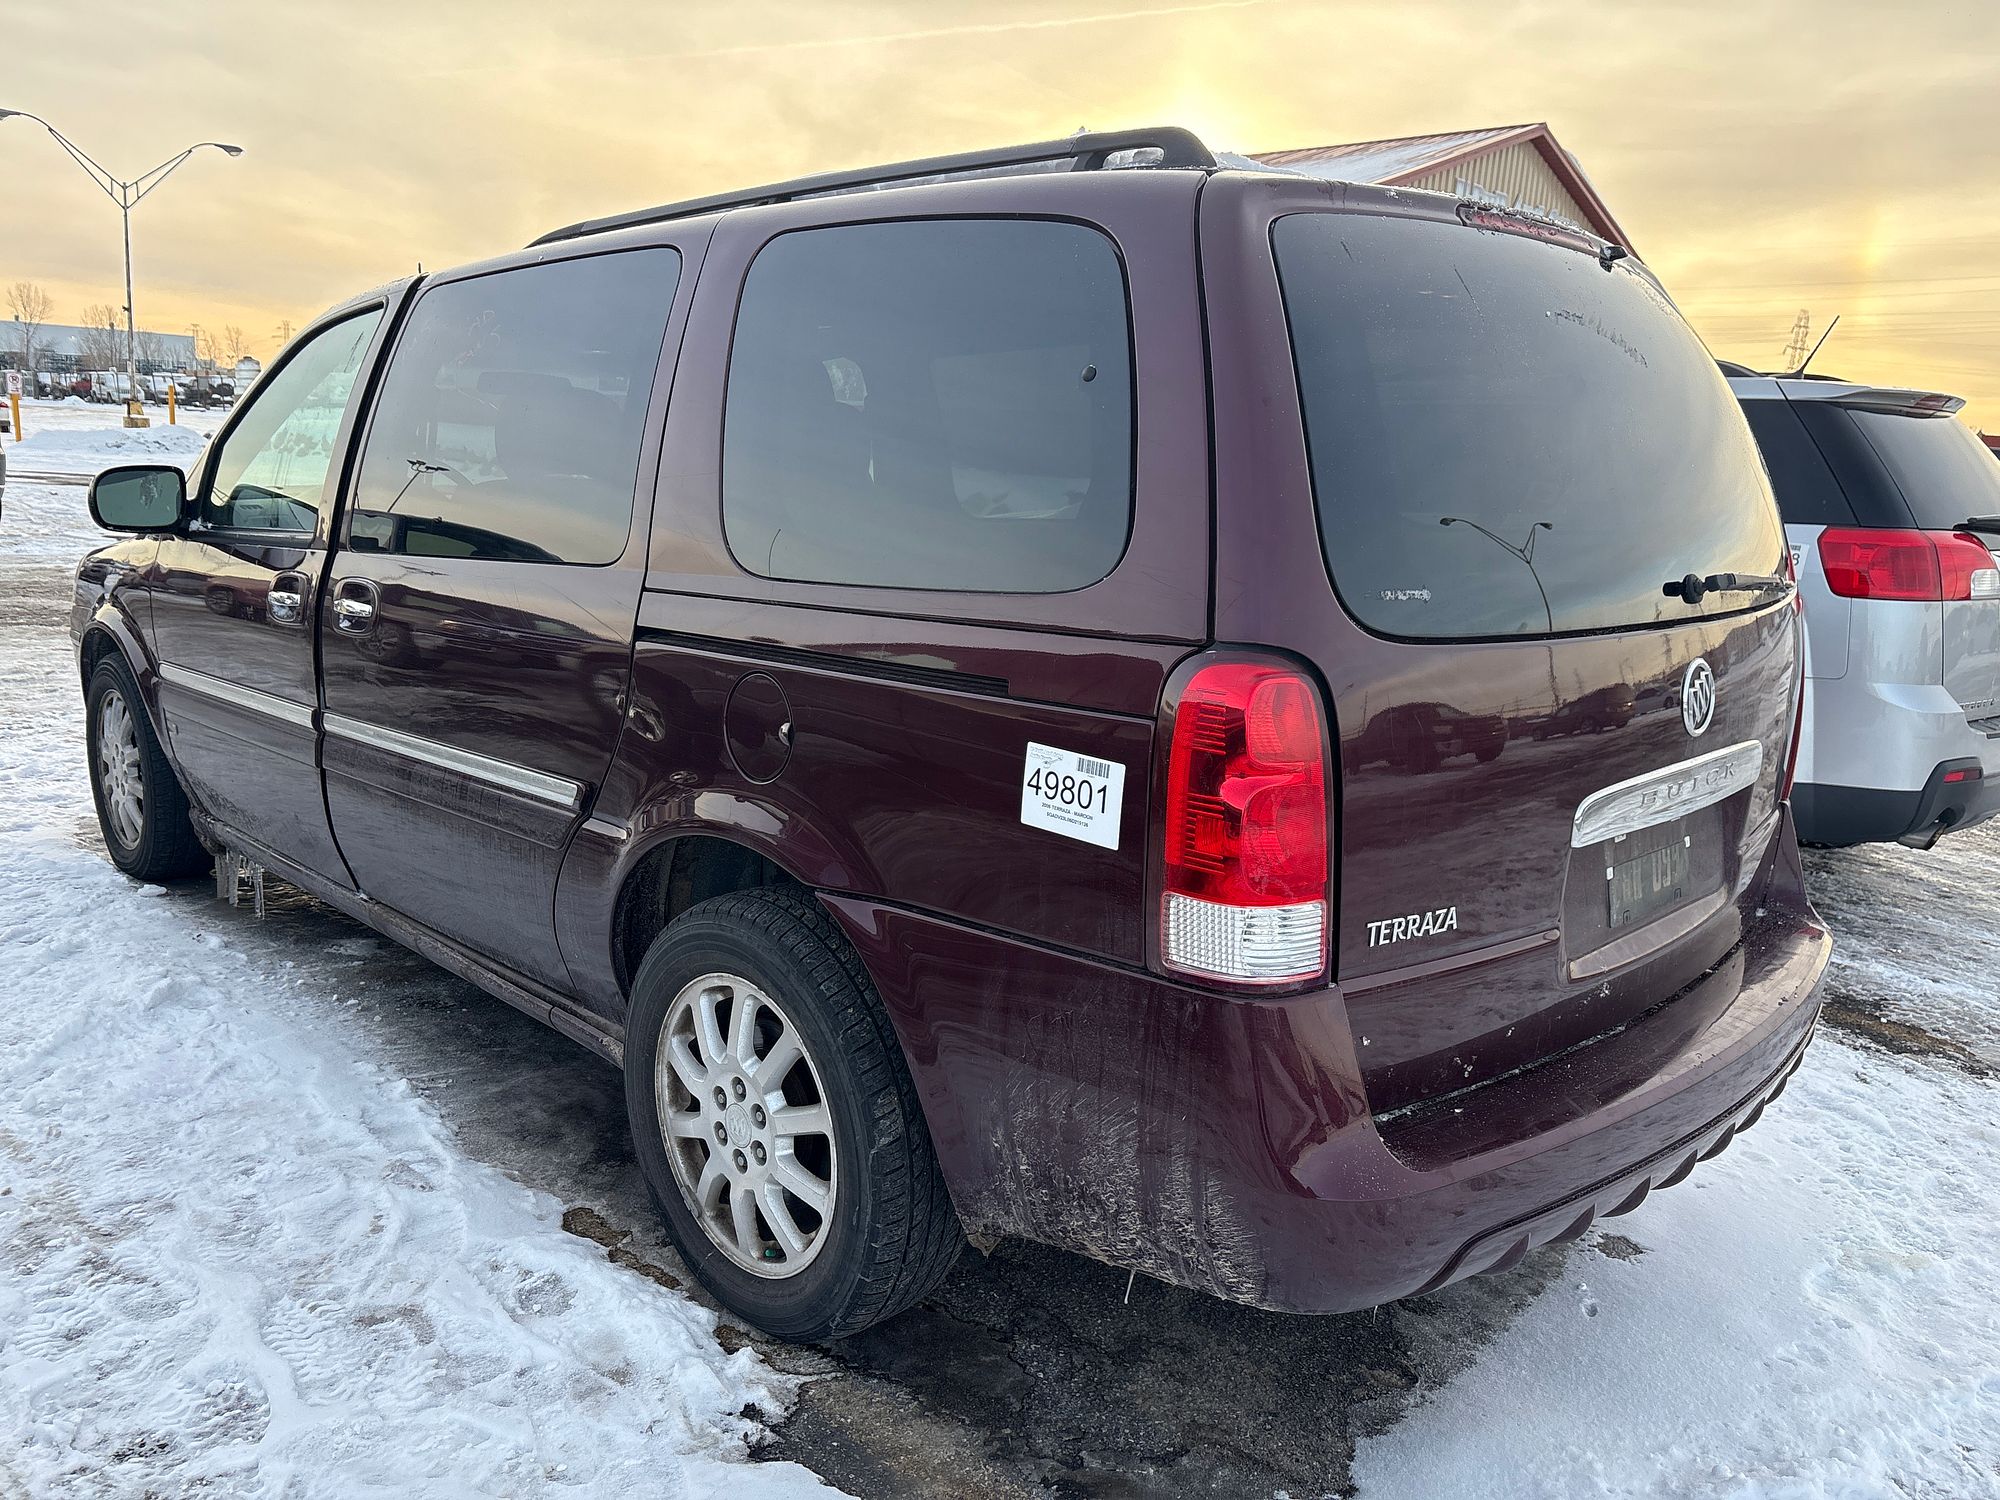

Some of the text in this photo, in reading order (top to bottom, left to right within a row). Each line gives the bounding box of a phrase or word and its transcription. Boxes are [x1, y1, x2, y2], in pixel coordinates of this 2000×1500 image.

[1027, 768, 1107, 813] 49801
[1640, 761, 1736, 808] BUICK
[1052, 804, 1071, 814] TERRAZA
[1074, 811, 1093, 820] MAROON
[1367, 906, 1458, 948] TERRAZA
